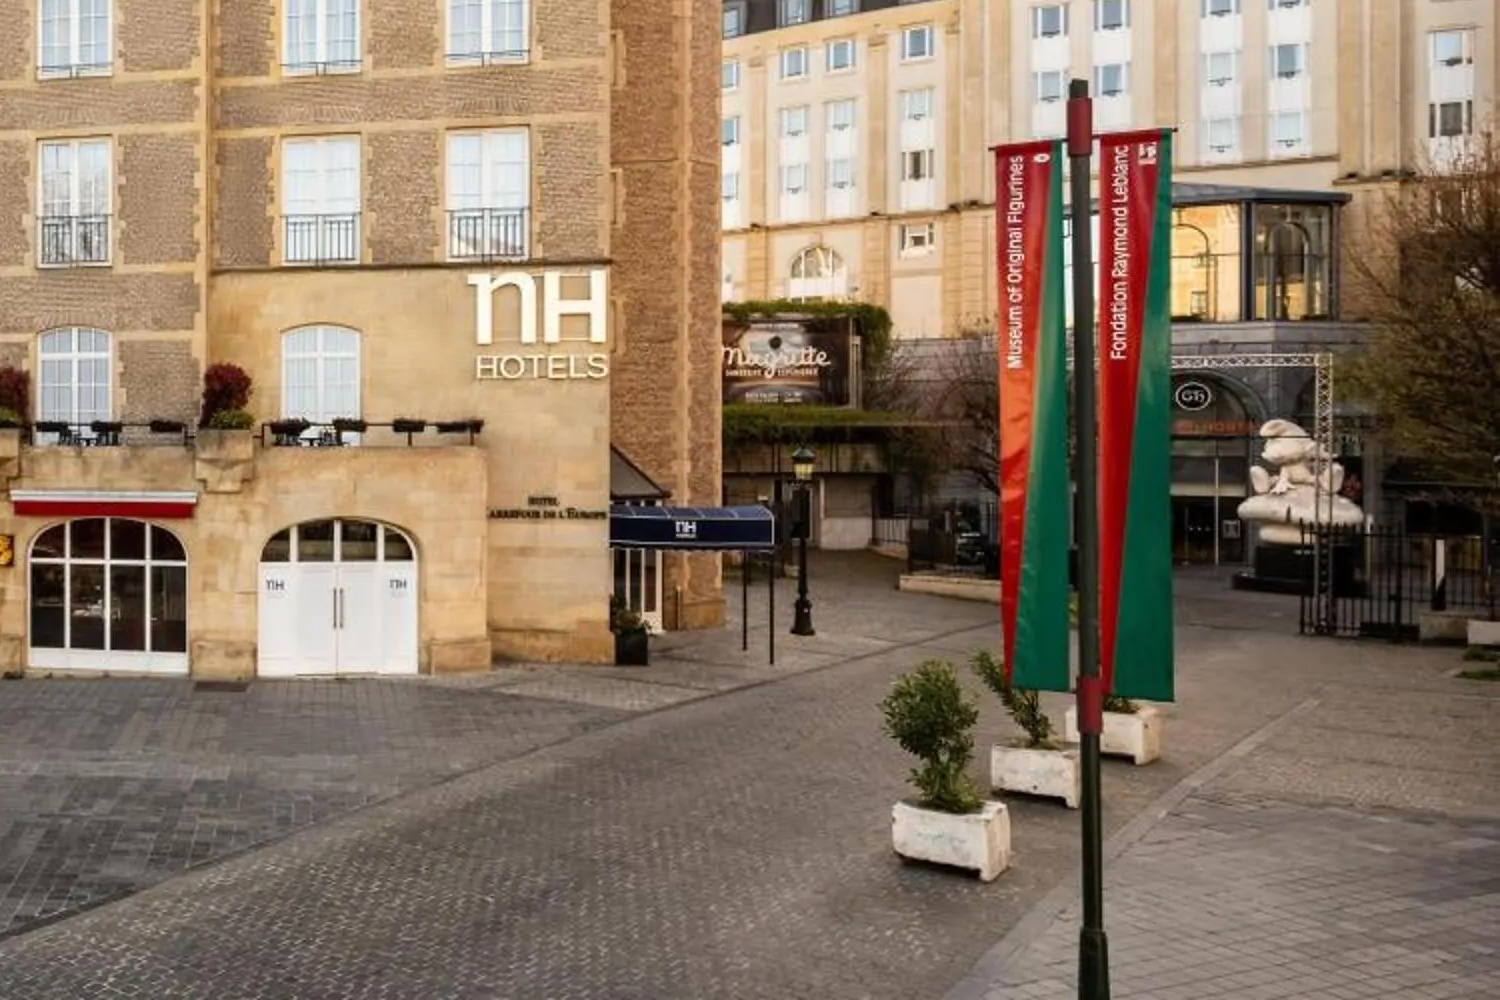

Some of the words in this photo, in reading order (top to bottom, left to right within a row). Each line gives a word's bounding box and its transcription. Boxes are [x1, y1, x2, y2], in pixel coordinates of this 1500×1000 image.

[1007, 155, 1024, 223] Figurines
[1111, 145, 1129, 203] Leblanc
[1007, 227, 1024, 283] Original
[1111, 207, 1130, 277] Raymond
[1007, 287, 1022, 303] of
[1110, 281, 1127, 360] Fondation
[476, 354, 609, 379] HOTELS
[1007, 306, 1023, 369] Museum
